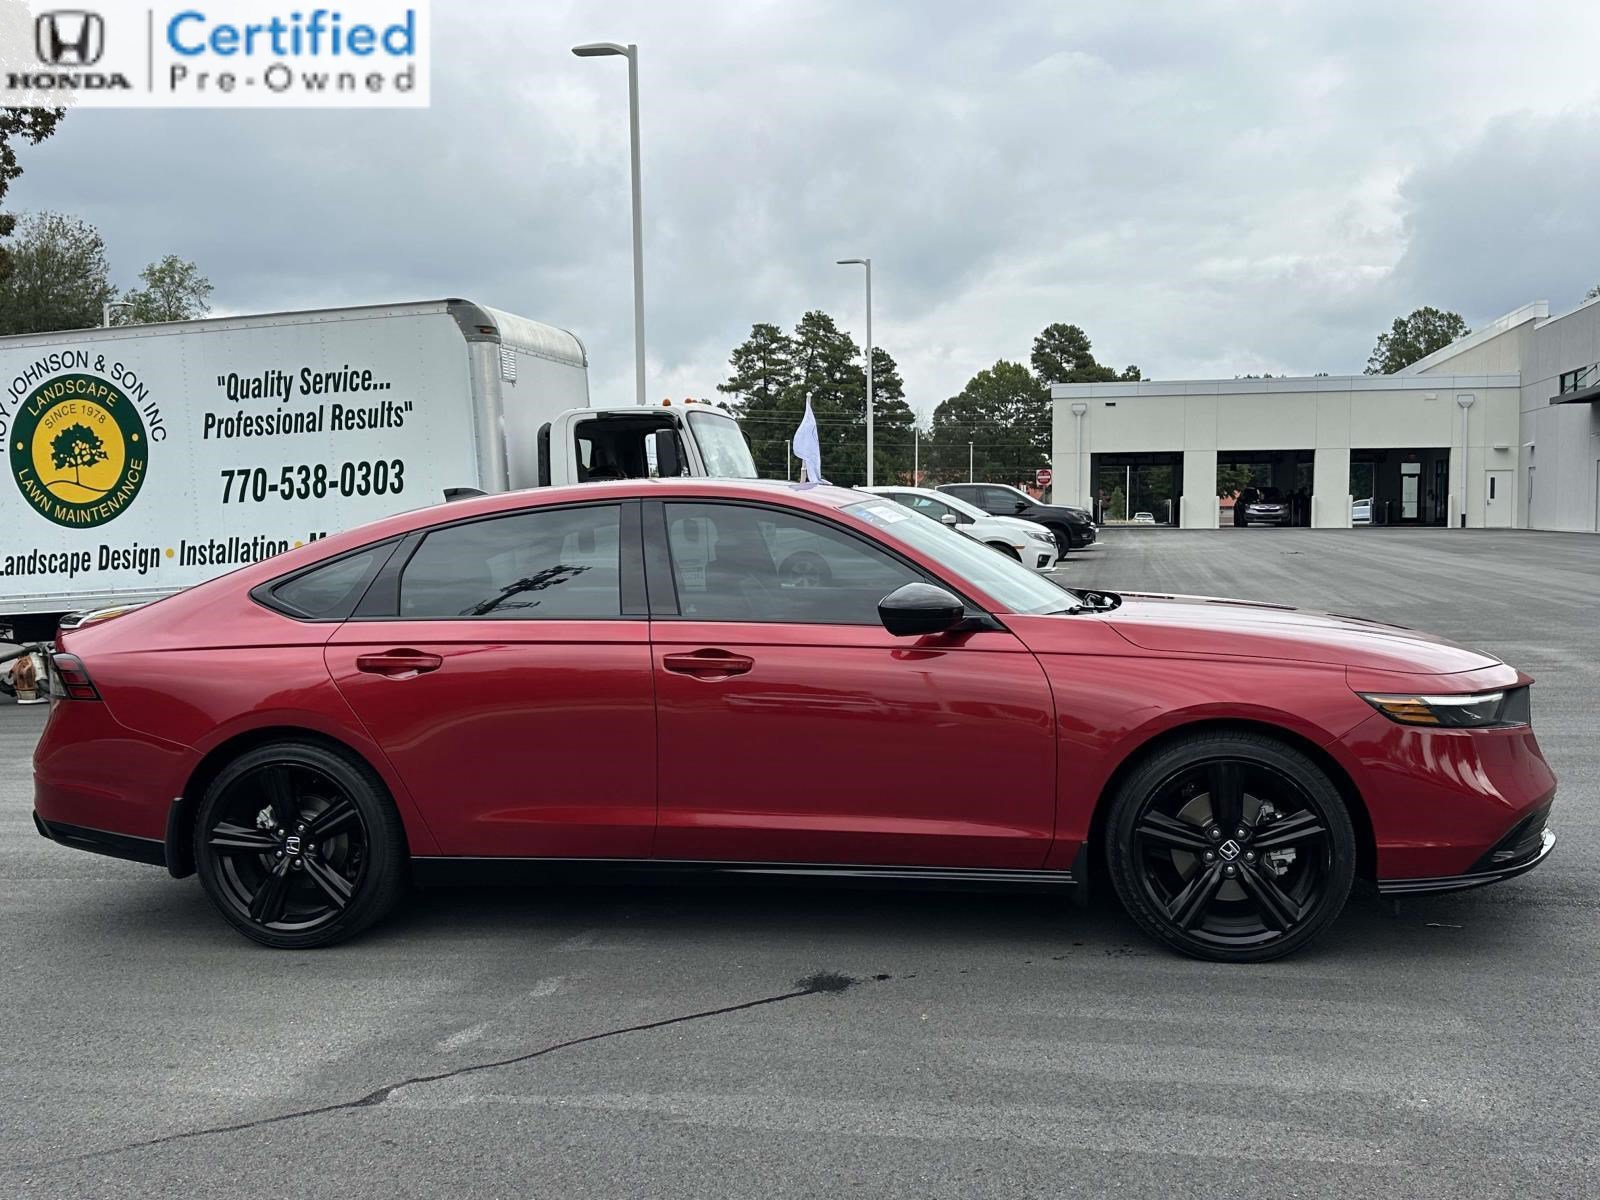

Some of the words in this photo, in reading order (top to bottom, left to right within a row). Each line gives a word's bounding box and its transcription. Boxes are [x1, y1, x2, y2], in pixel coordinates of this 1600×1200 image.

[8, 350, 89, 405] JOHNSON
[94, 354, 105, 373] &
[110, 362, 149, 402] SON
[143, 402, 167, 443] INC
[27, 379, 118, 417] LANDSCAPE
[217, 370, 293, 402] "Quality
[300, 365, 391, 396] Service...
[44, 404, 77, 429] SINCE
[81, 404, 107, 424] 1978
[203, 404, 324, 439] Professional
[330, 401, 413, 431] Results"
[18, 469, 52, 513] LAWN
[54, 458, 143, 523] MAINTENANCE
[221, 459, 405, 503] 770-538-0303
[99, 543, 160, 575] Design
[180, 534, 289, 566] Installation
